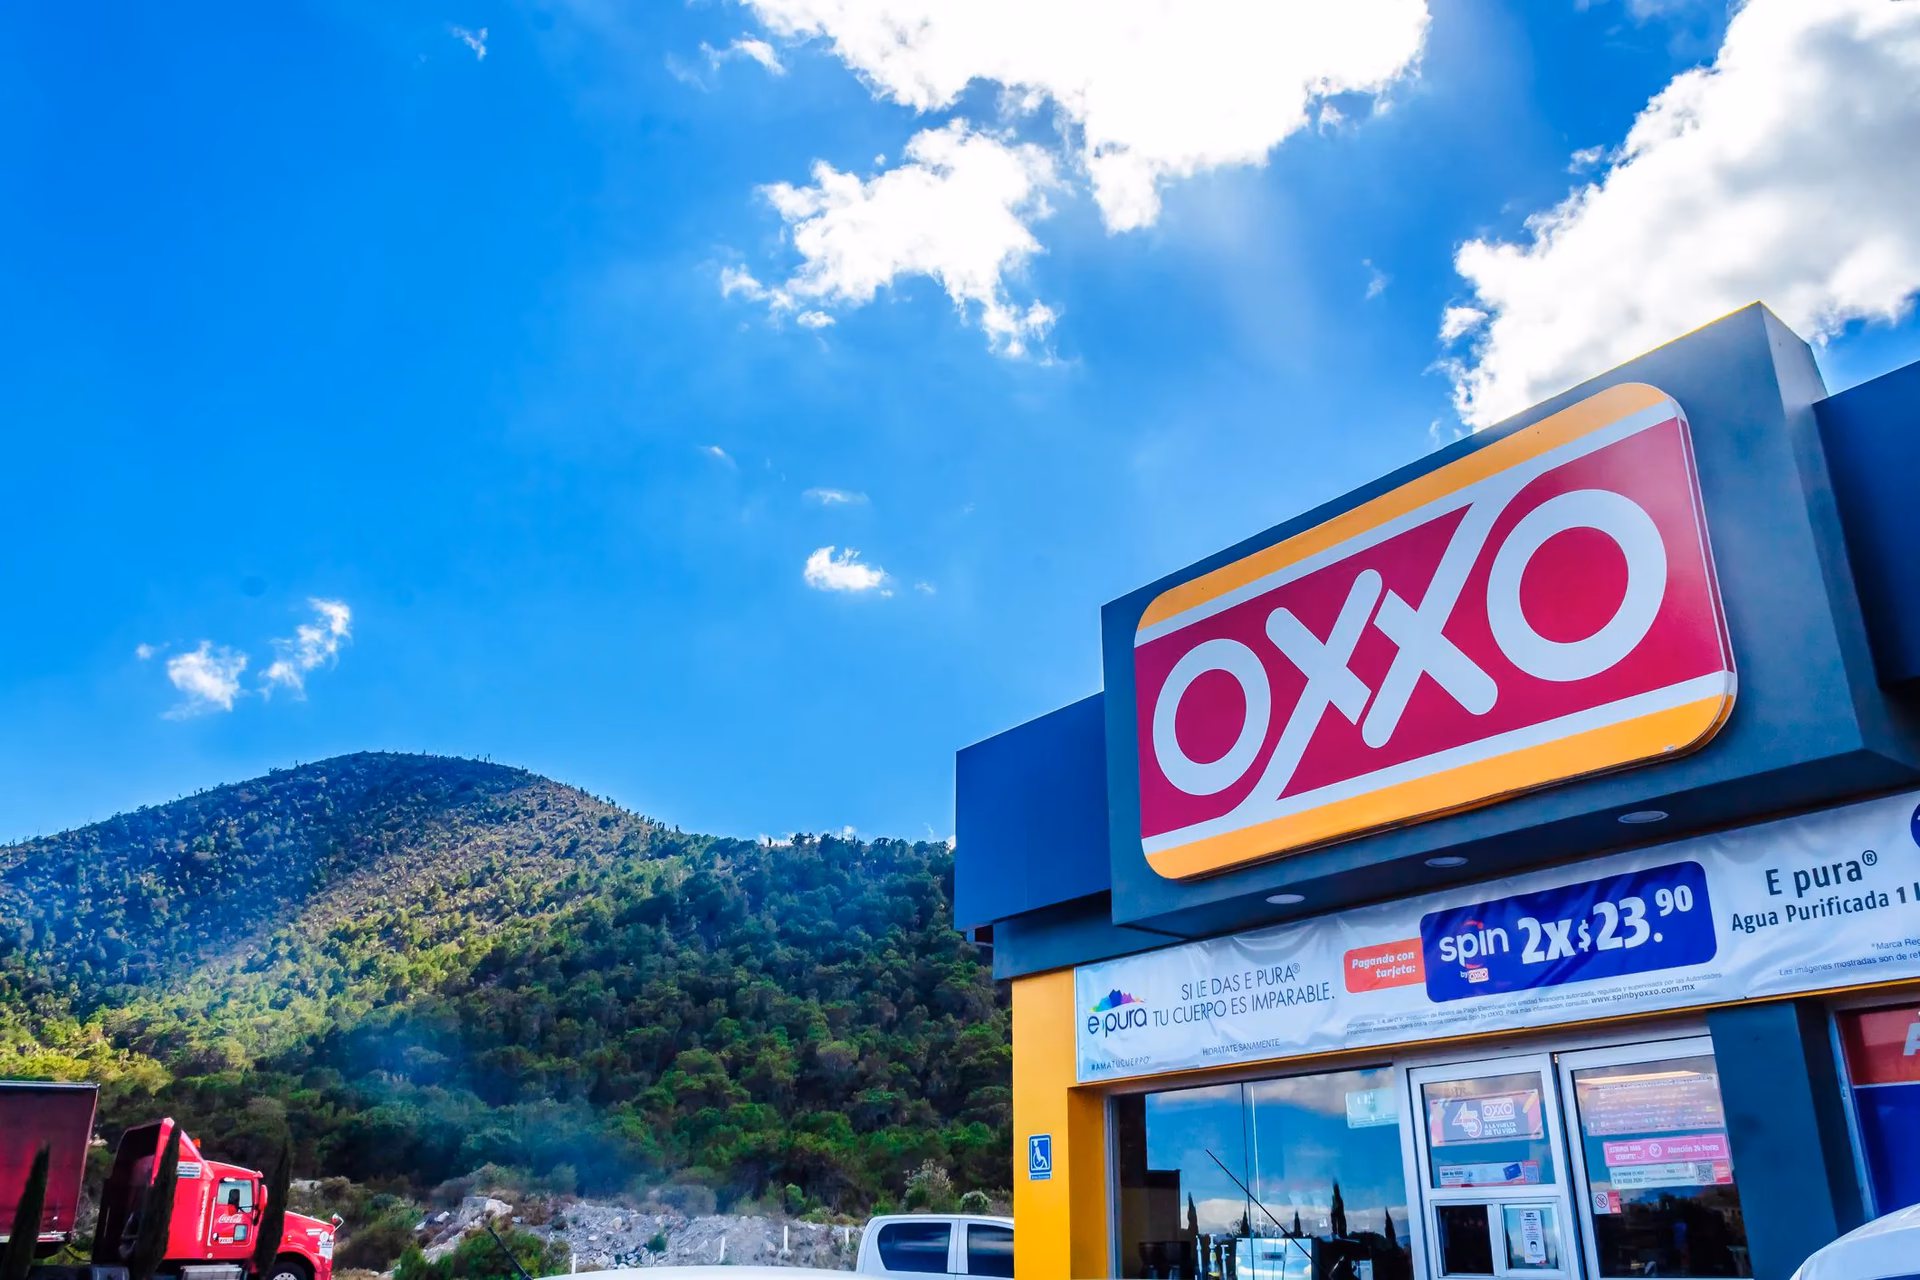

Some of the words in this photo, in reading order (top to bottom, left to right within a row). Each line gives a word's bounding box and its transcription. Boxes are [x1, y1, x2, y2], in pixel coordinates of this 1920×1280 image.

[1153, 489, 1667, 808] OXXO
[1765, 868, 1782, 896] E
[1732, 911, 1779, 934] Agua
[1786, 890, 1890, 923] Purificada
[1896, 886, 1907, 904] 1
[1438, 922, 1510, 969] spin
[1352, 954, 1395, 970] Pagando
[1396, 950, 1415, 962] con
[1779, 968, 1793, 976] Las
[1795, 963, 1832, 975] imágenes
[1834, 956, 1877, 968] mostradas
[1878, 954, 1895, 963] son
[1896, 951, 1907, 961] de
[1375, 963, 1417, 979] tarjeta:
[1459, 970, 1468, 979] by
[1686, 972, 1722, 982] Autoridades
[1181, 983, 1192, 1001] SI
[1196, 979, 1207, 999] LE
[1211, 974, 1241, 995] DAS
[1244, 971, 1253, 990] E
[1591, 983, 1695, 1003] www.spinbyoxxo.com.mx
[1153, 1009, 1169, 1027] TU
[1173, 1000, 1227, 1024] CUERPO
[1231, 996, 1247, 1015] ES
[1251, 981, 1336, 1012] IMPARABLE.
[1239, 1037, 1280, 1052] SANAMENTE
[1091, 1055, 1150, 1071] #AMATUCUERPO
[1484, 1103, 1512, 1117] OXXO
